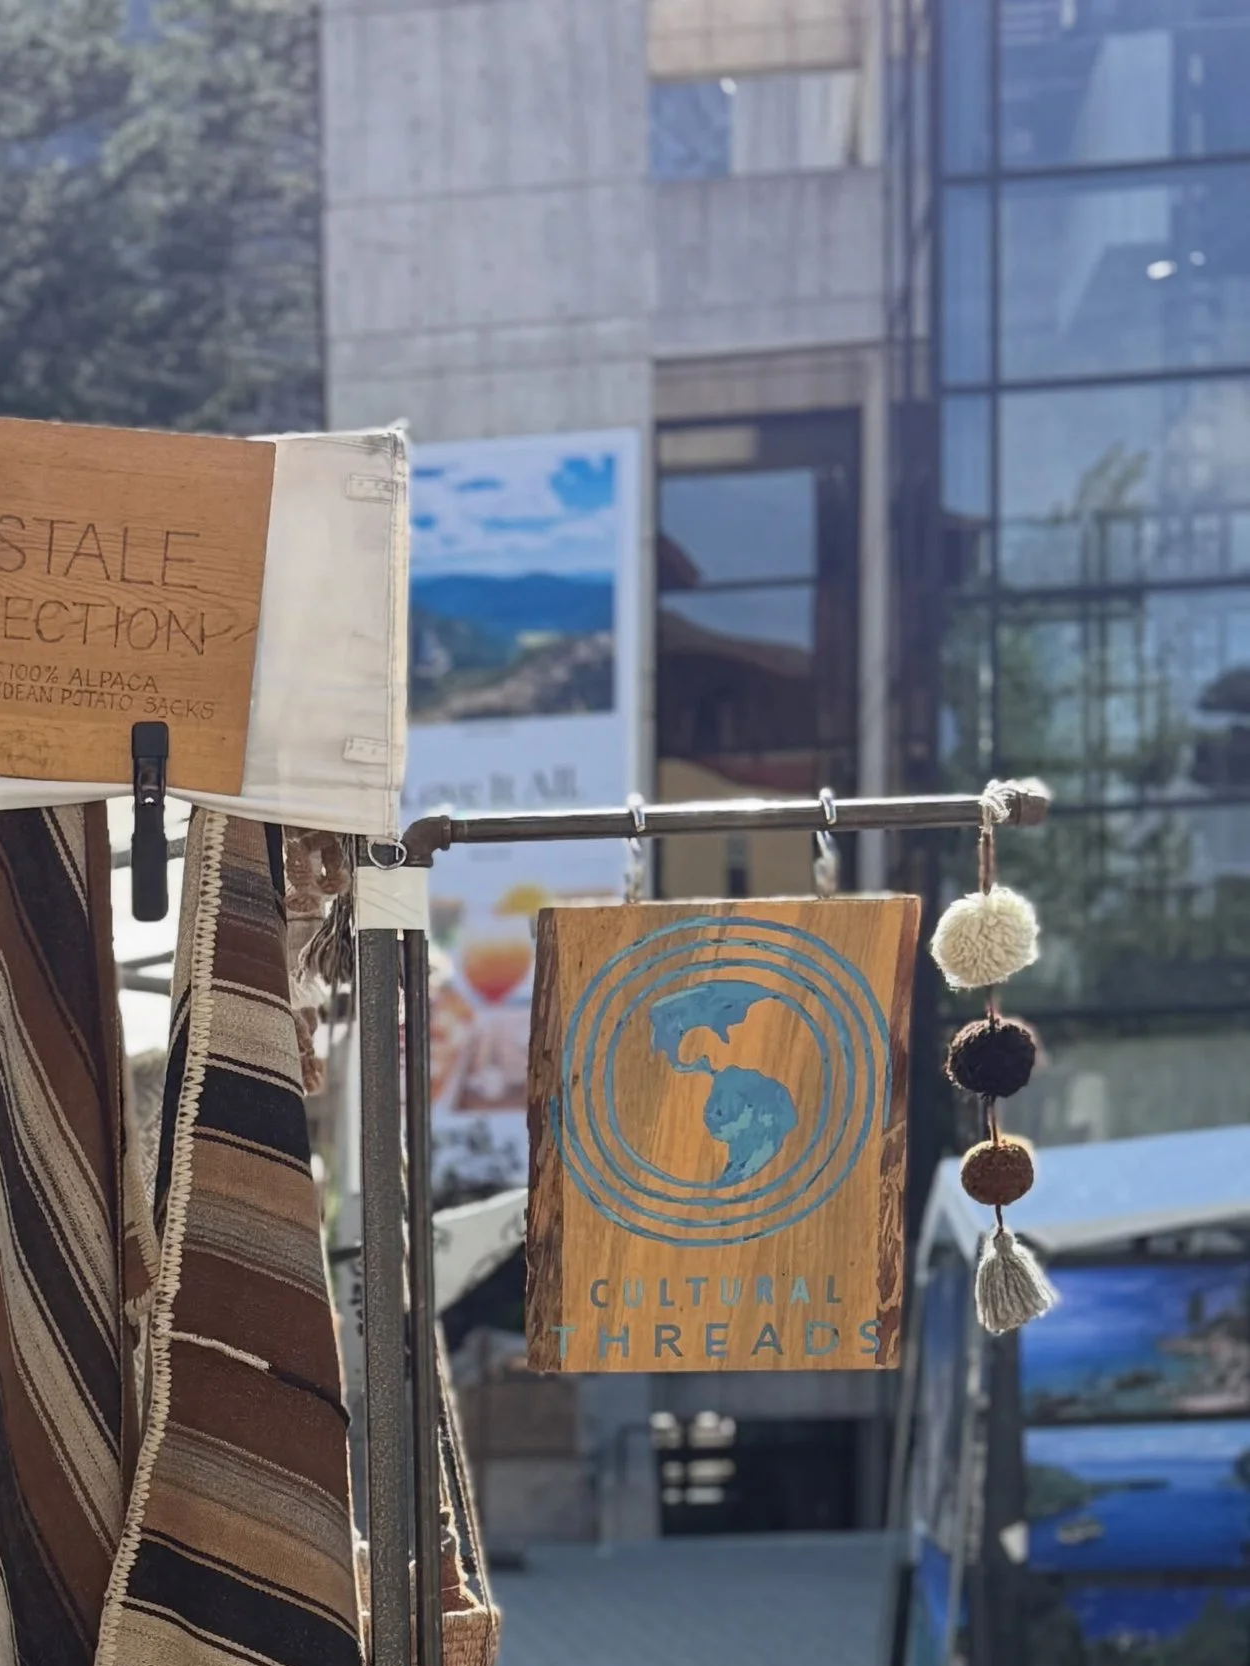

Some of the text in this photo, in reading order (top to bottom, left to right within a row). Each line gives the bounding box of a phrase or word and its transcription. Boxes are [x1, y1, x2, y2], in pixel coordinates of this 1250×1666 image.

[9, 663, 58, 684] 100%
[68, 667, 159, 694] ALPACA
[61, 688, 133, 711] POTATO
[144, 697, 215, 720] SACKS
[590, 1275, 843, 1309] CULTURAL
[551, 1319, 883, 1360] THREADS
